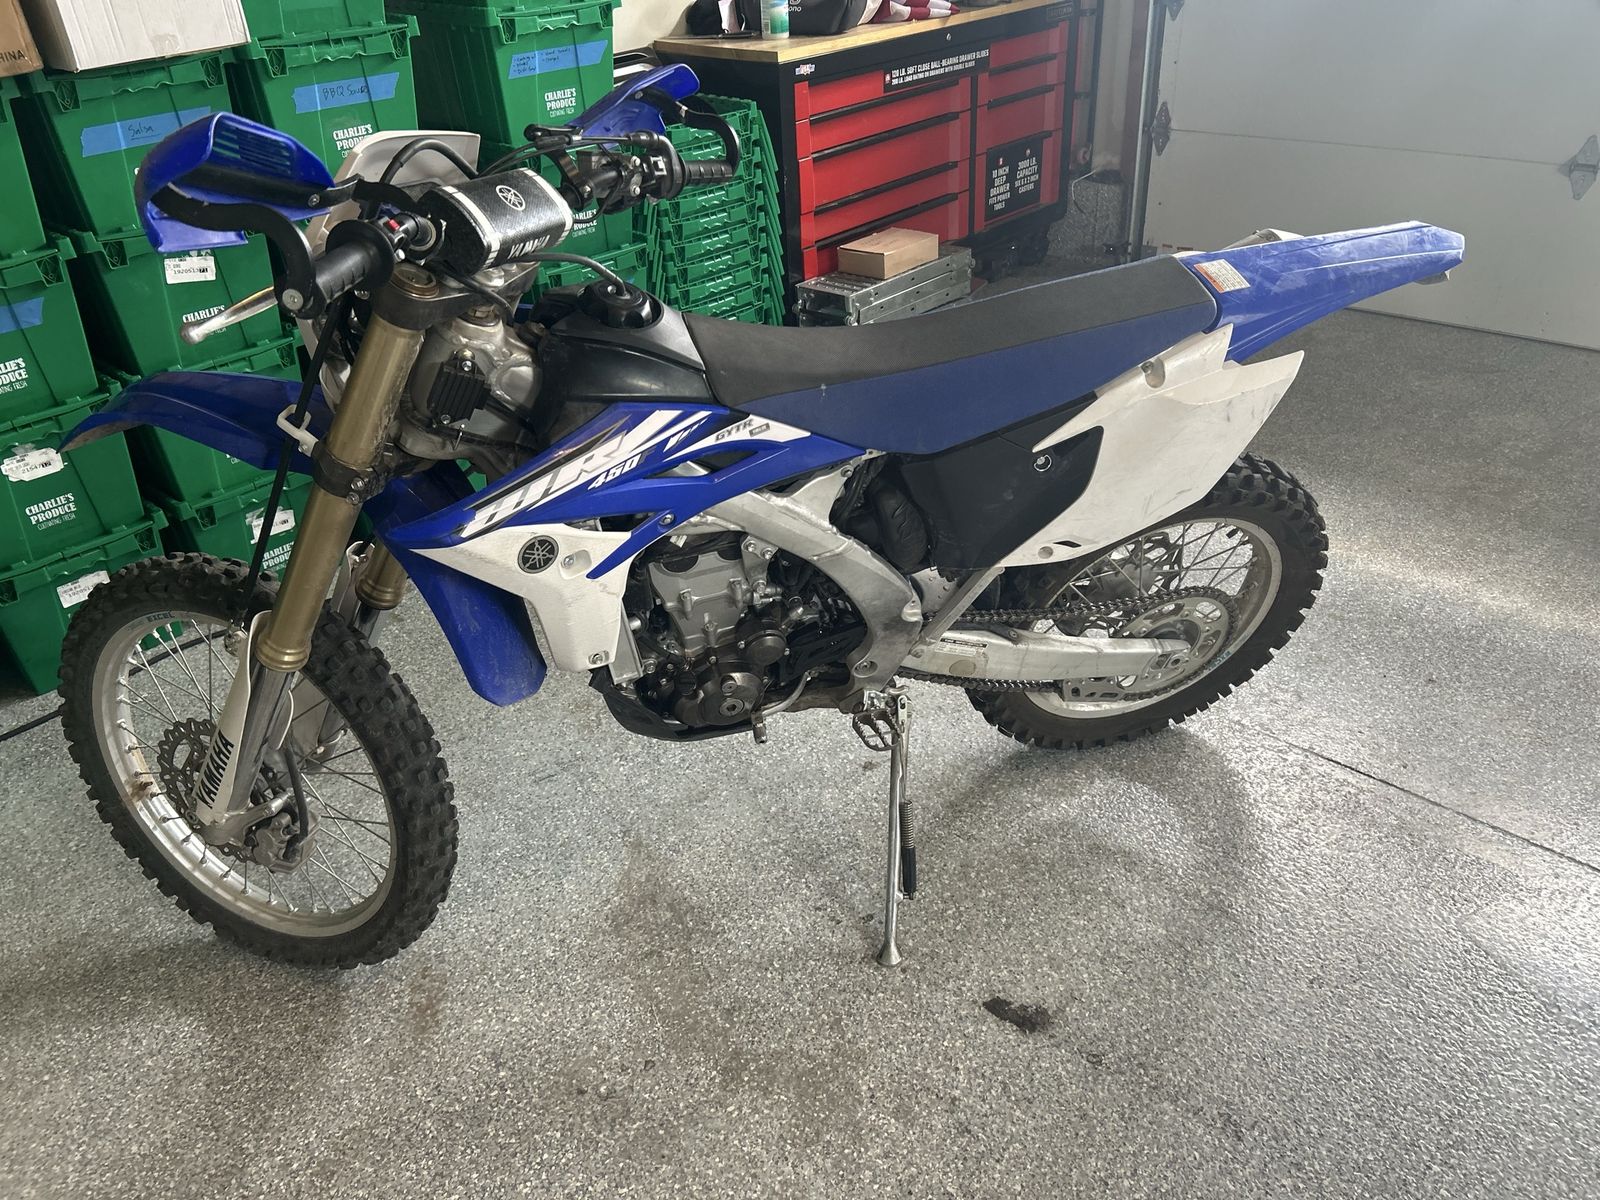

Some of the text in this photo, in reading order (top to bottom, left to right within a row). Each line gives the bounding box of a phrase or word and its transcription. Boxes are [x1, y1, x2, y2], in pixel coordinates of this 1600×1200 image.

[907, 65, 918, 74] SOFT
[918, 62, 931, 72] CLOSE
[931, 57, 959, 68] BALL-BEARING
[960, 52, 976, 63] DRAWER
[976, 49, 990, 59] SLIDES
[322, 85, 345, 101] BBQ
[544, 88, 577, 102] CHARLIE'S
[546, 97, 577, 111] PRODUCE
[333, 123, 373, 141] CHARLIE'S
[992, 166, 1009, 178] 10 INCH
[1016, 165, 1038, 179] CAPACITY
[994, 176, 1006, 186] DEEP
[1019, 183, 1034, 193] CASTERS
[990, 183, 1010, 197] DRAWER
[994, 201, 1005, 210] TOOLS
[715, 419, 754, 442] GYTR
[25, 492, 75, 516] CHARLIE'S
[29, 502, 77, 525] PRODUCE
[195, 729, 235, 810] YAMAHA
